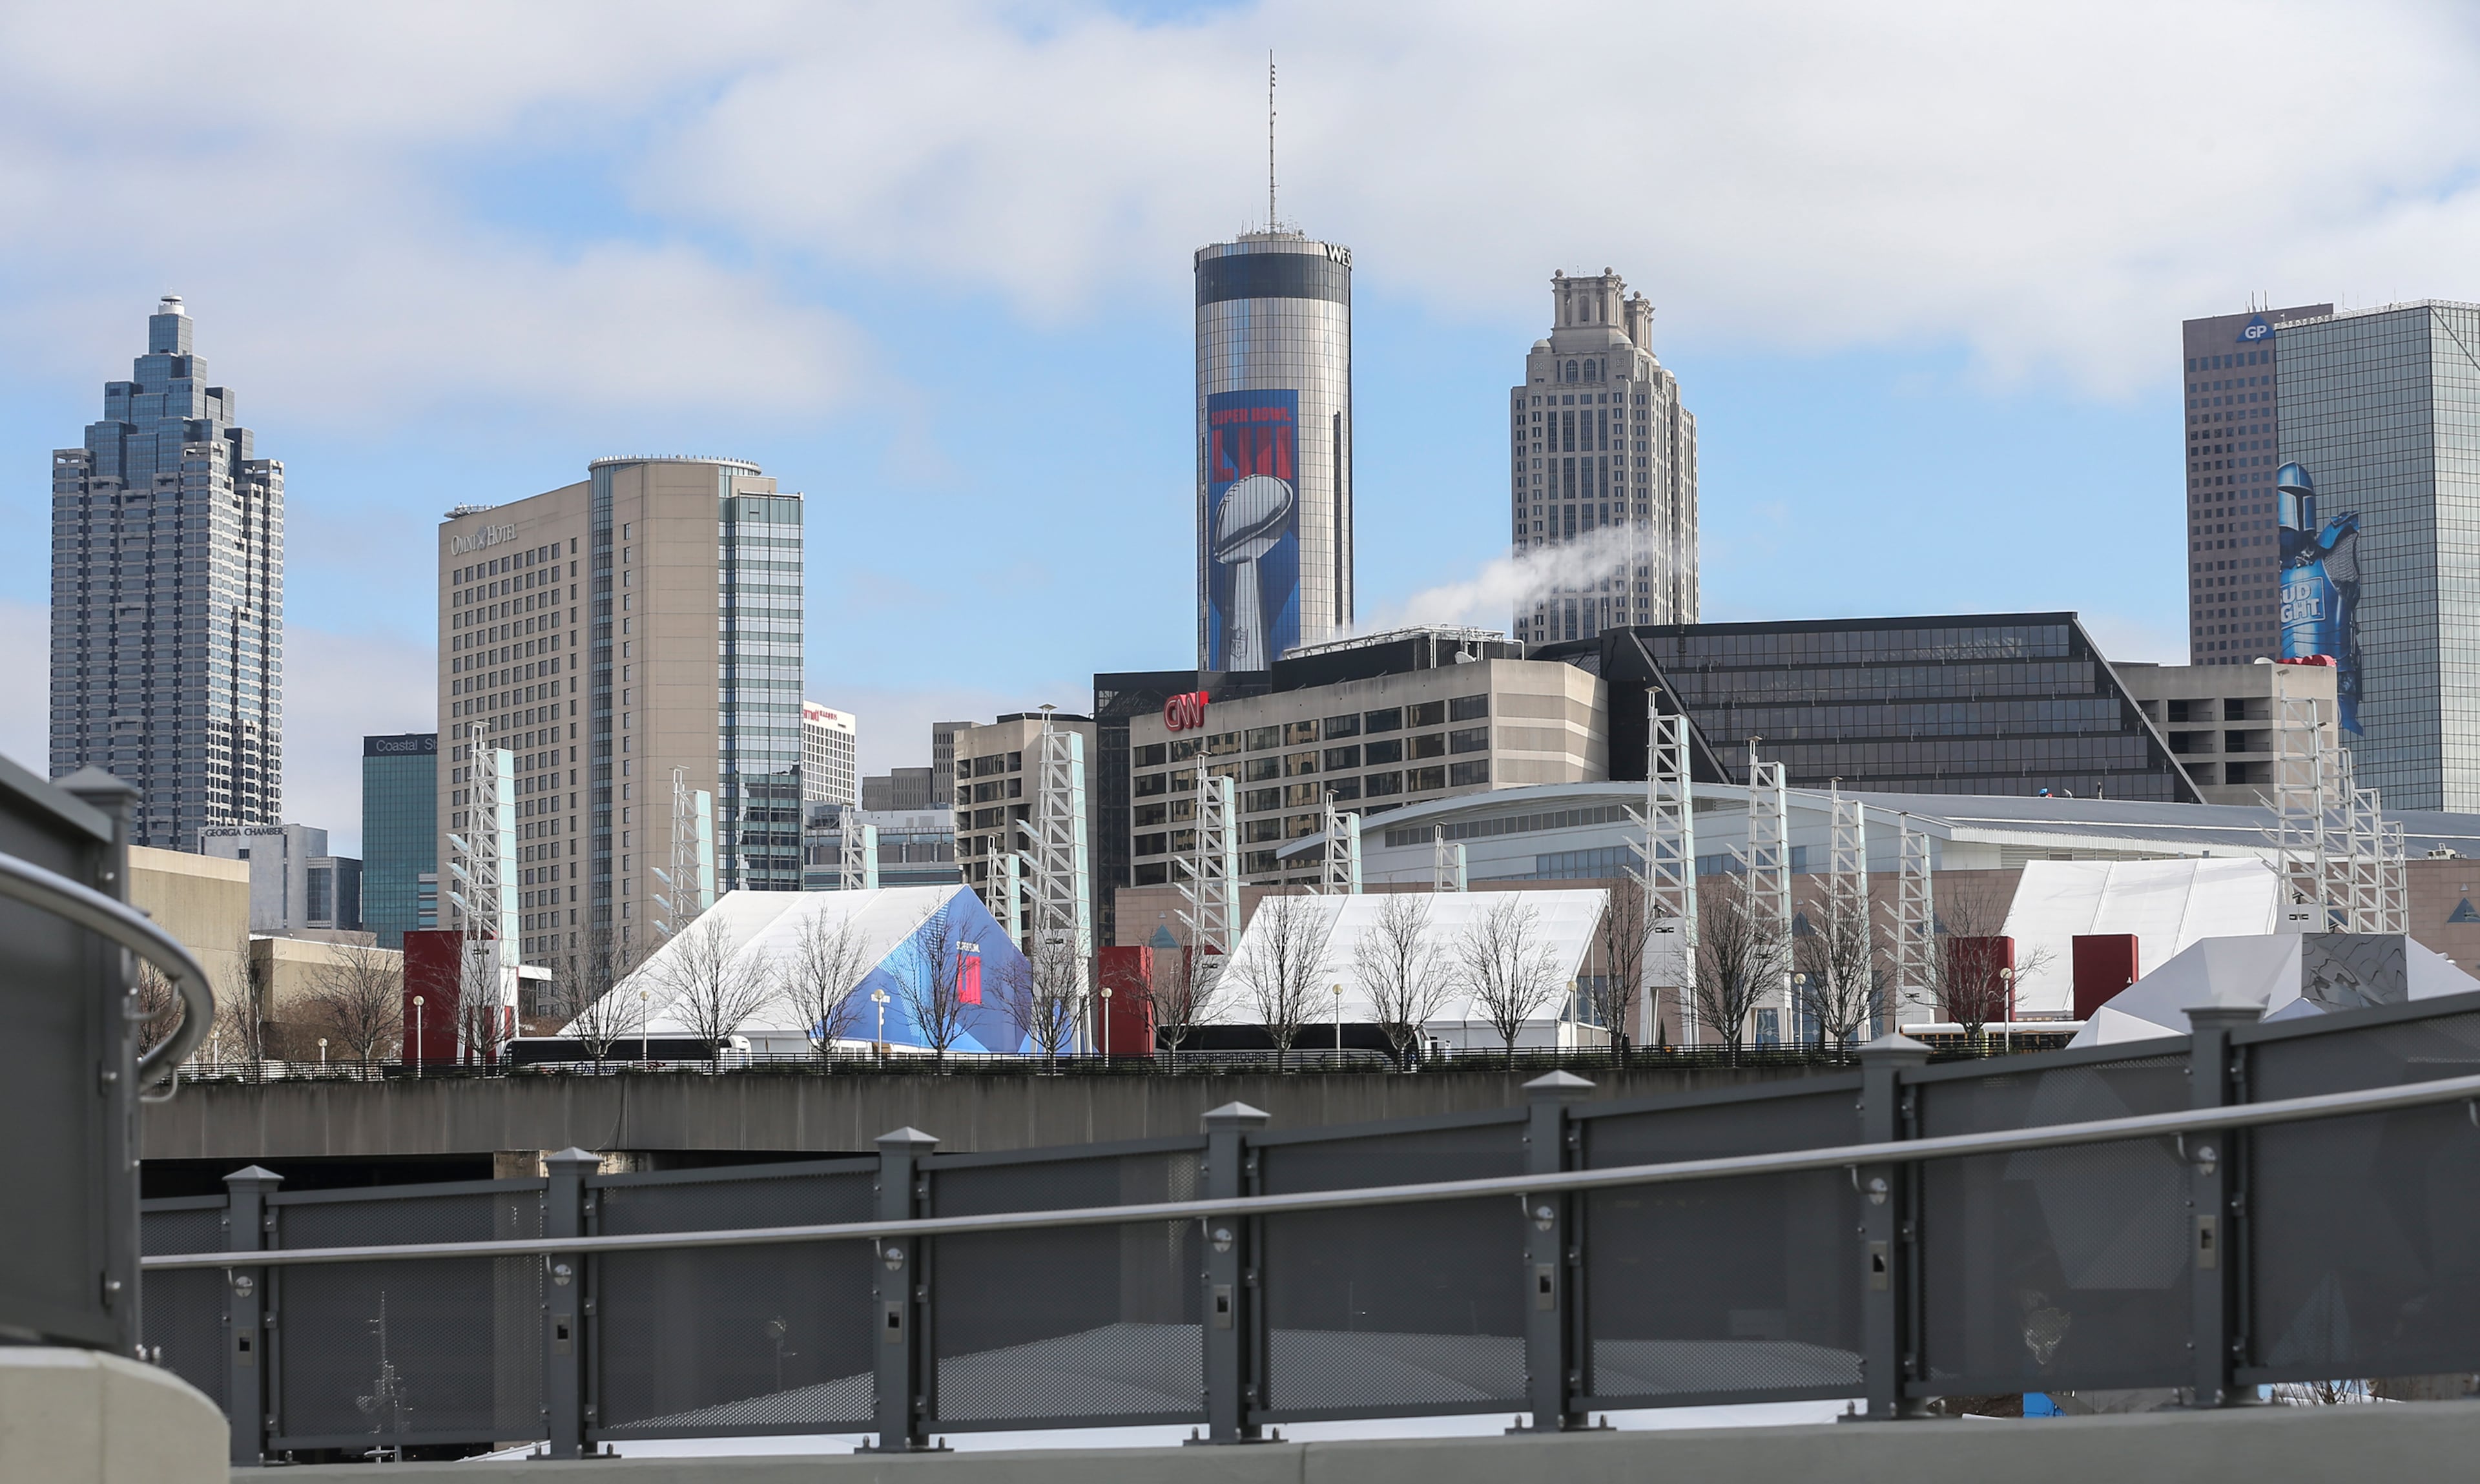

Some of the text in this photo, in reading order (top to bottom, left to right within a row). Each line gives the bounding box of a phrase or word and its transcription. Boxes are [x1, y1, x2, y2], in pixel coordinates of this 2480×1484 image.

[1324, 243, 1351, 267] WES
[2245, 325, 2267, 339] GP
[1212, 406, 1292, 426] SUPER BOWL
[1212, 426, 1292, 483] LIII
[451, 524, 517, 556] OMNI HOTEL
[2280, 583, 2311, 604] UD
[1164, 690, 1206, 731] CNN
[376, 737, 437, 752] Coastal St
[205, 827, 284, 838] GEORGIA CHAMBER
